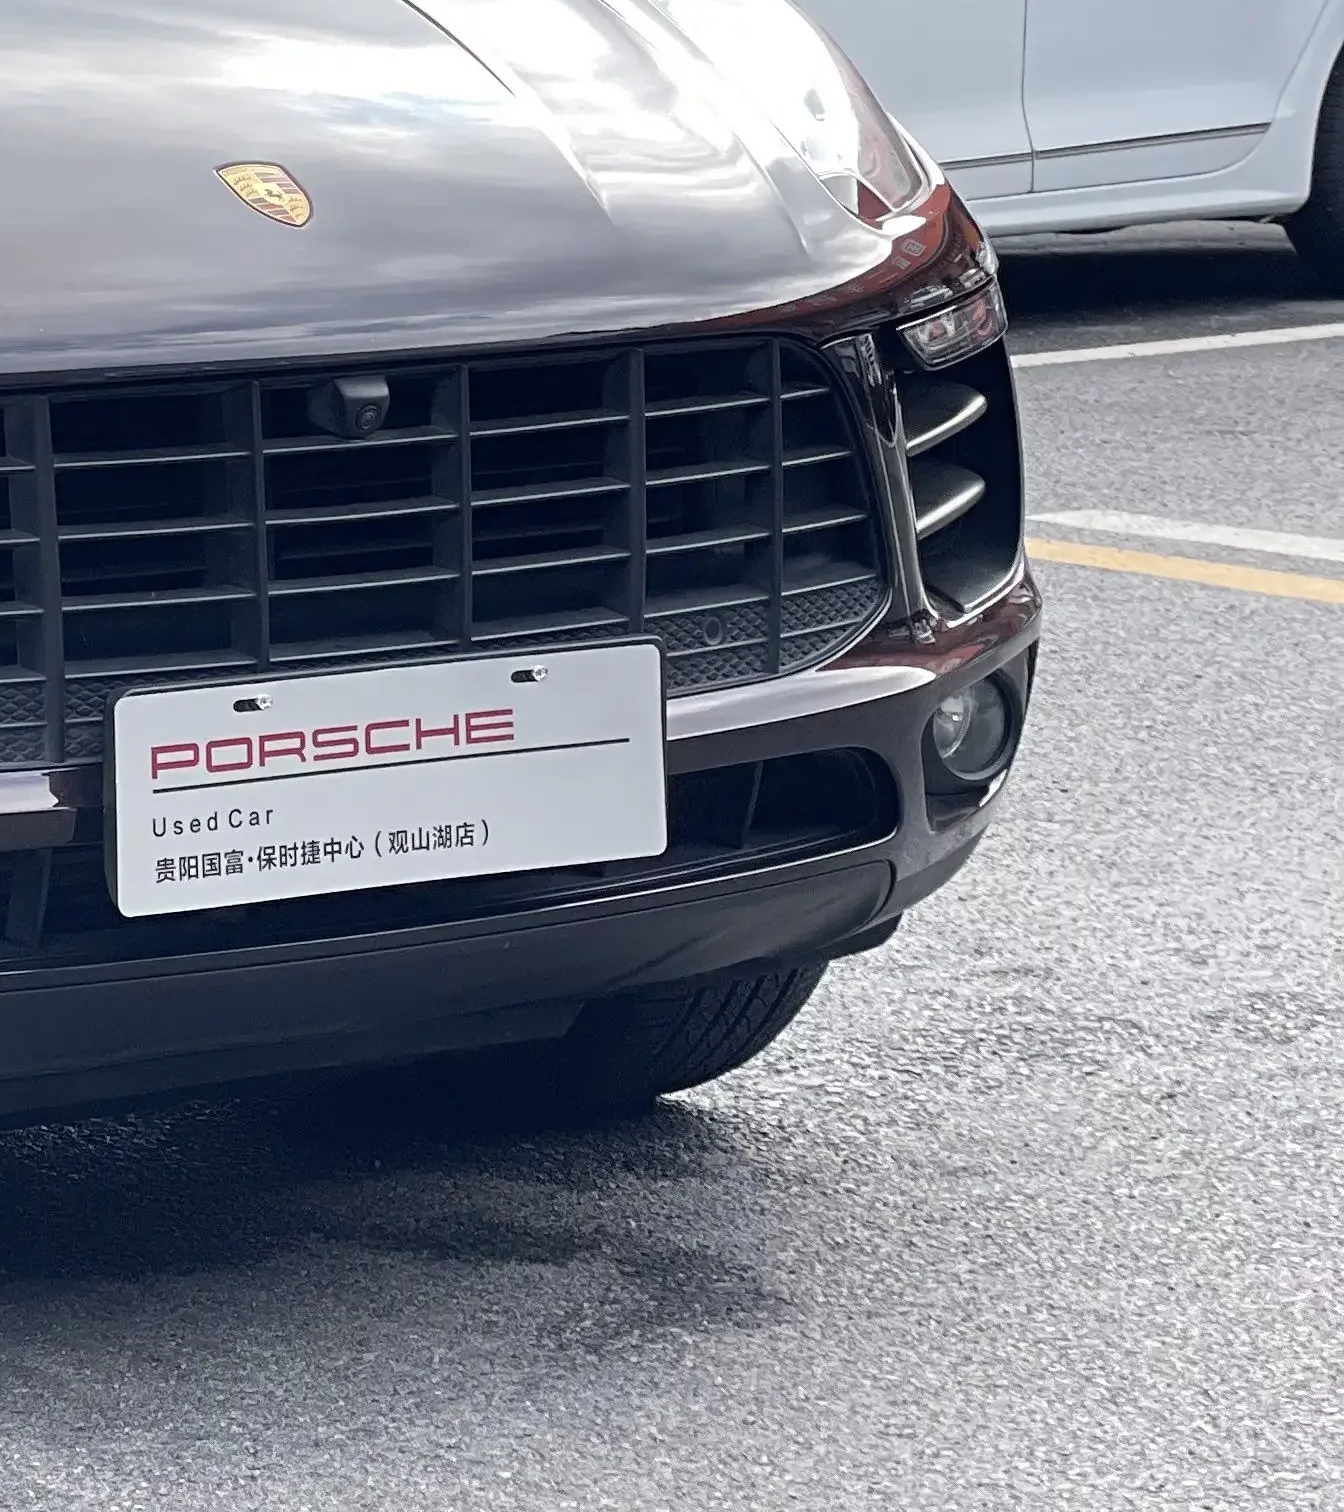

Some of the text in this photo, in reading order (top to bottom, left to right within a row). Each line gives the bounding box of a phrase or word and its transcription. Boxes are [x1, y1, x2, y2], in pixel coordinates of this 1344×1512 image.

[151, 708, 515, 780] PORSCHE
[152, 806, 275, 838] Used Car
